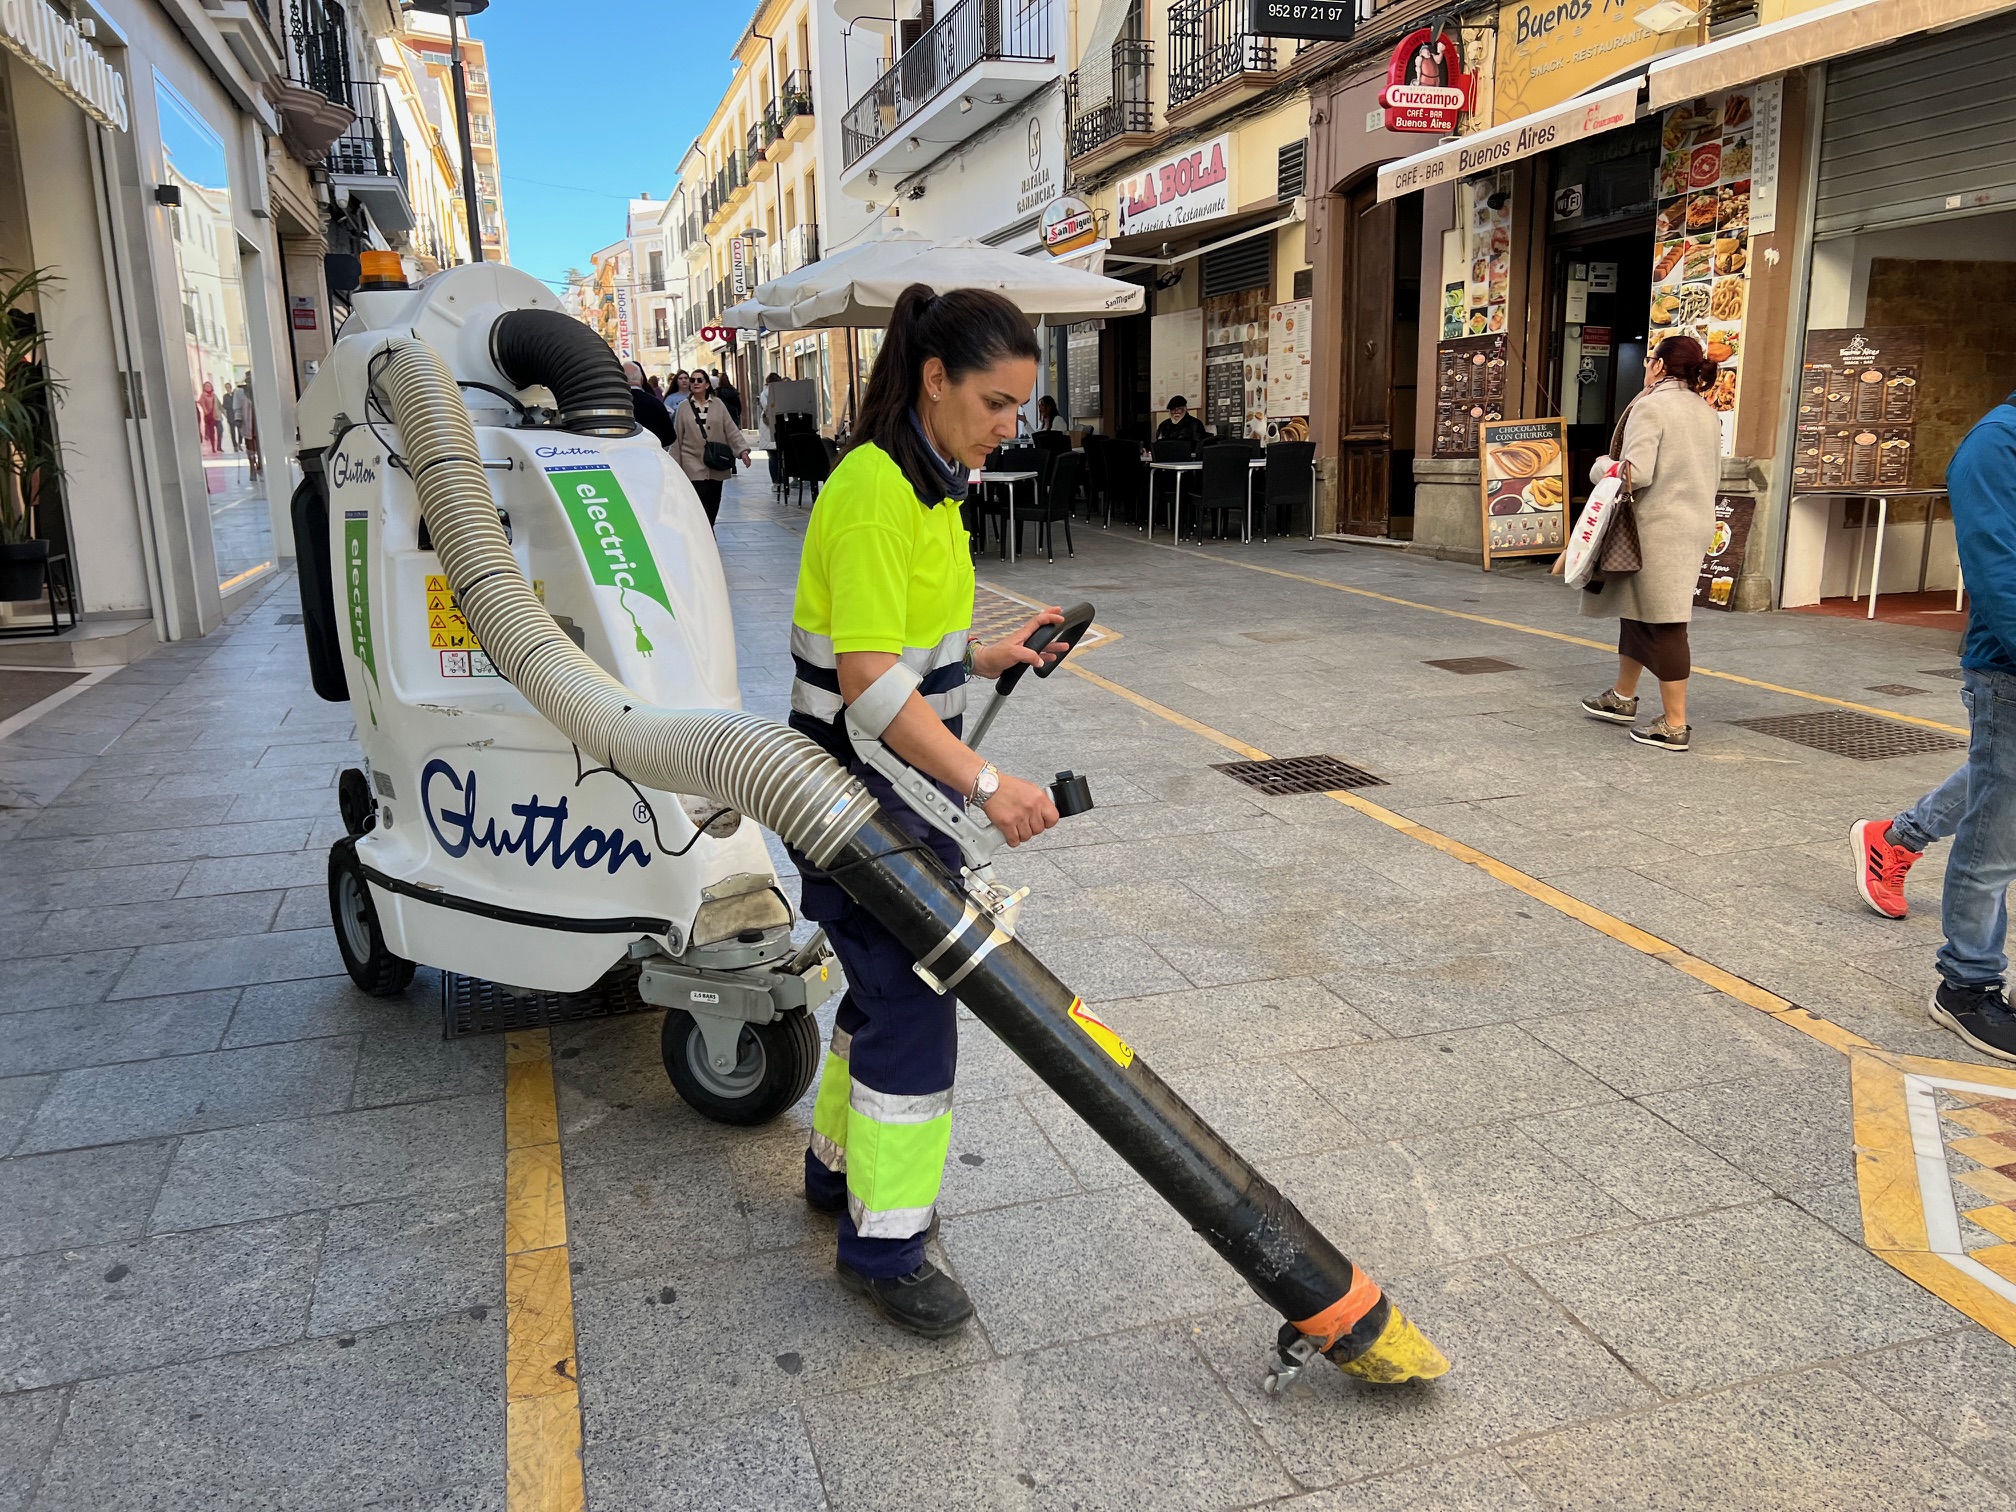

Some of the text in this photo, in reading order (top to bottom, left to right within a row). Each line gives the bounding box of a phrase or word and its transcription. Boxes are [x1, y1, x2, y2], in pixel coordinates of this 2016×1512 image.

[1268, 3, 1343, 20] 952 87 21 97
[1516, 0, 1592, 45] Buenos
[1530, 58, 1563, 79] SNACK
[1573, 29, 1651, 64] RESTAURANTE
[1392, 89, 1459, 107] Cruzcampo
[1396, 117, 1452, 129] Buenos Aires
[1407, 108, 1424, 117] CAFÉ
[1429, 110, 1443, 118] BAR
[1592, 113, 1624, 130] Cruzcampo
[1396, 166, 1418, 189] CAFÉ
[1426, 161, 1444, 180] BAR
[1459, 140, 1510, 172] Buenos
[1516, 125, 1555, 153] Aires
[1021, 168, 1050, 194] NATALIA
[1127, 142, 1227, 218] LA BOLA
[1175, 197, 1226, 224] Restaurante
[733, 241, 744, 293] GALINDO
[617, 288, 629, 349] INTERSPORT
[1495, 430, 1554, 442] CON CHURROS
[1498, 424, 1547, 434] CHOCOLATE
[535, 446, 600, 458] Glutton
[333, 451, 375, 489] Glutton
[576, 483, 637, 588] electric
[1710, 559, 1730, 575] Tapas
[351, 538, 367, 661] electric
[421, 758, 651, 874] Glutton
